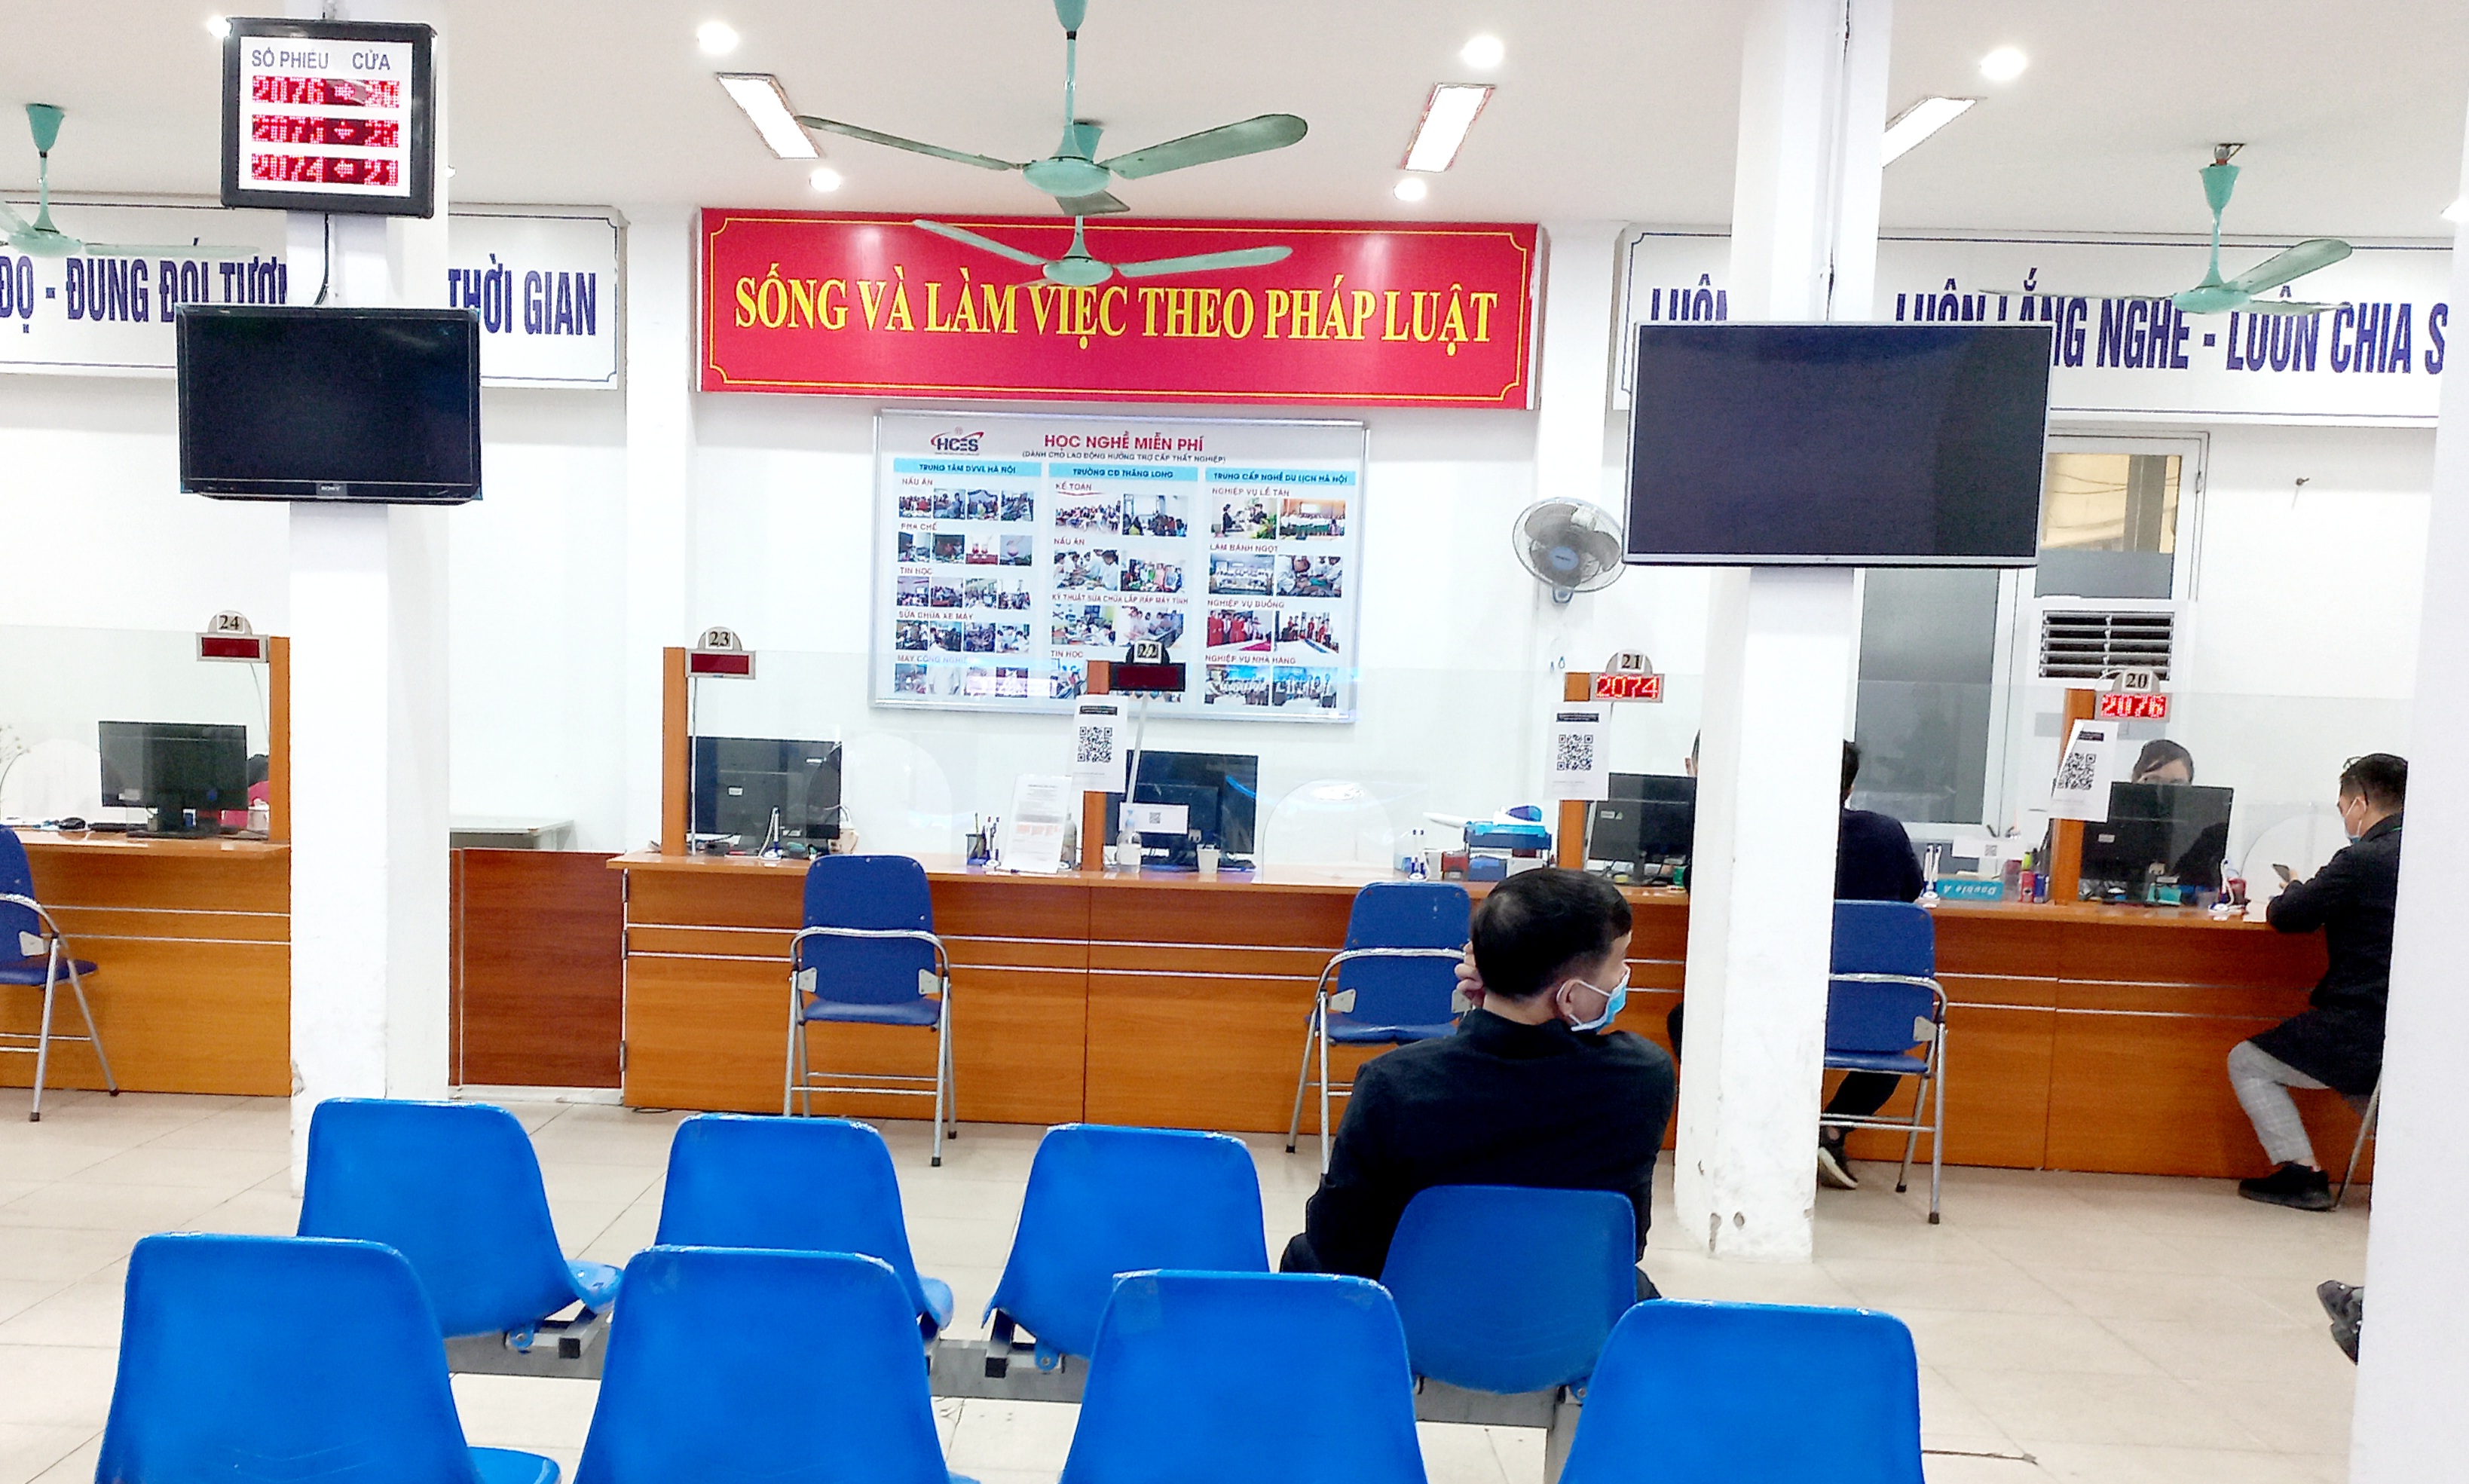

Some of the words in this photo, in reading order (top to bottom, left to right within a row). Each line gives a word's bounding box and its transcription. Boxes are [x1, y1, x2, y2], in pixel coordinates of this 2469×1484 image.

[252, 47, 275, 67] SỐ
[352, 49, 390, 70] CỬA
[252, 154, 324, 182] 2074
[365, 158, 398, 186] 21
[524, 270, 596, 335] GIAN
[735, 262, 849, 330] SỐNG
[856, 265, 914, 332] VÀ
[924, 267, 1019, 334] LÀM
[1137, 287, 1256, 339] THEO
[1263, 274, 1377, 341] PHÁP
[1381, 282, 1498, 356] LUẬT
[2096, 297, 2190, 369] NGHE
[2331, 301, 2412, 373] CHIA
[2425, 303, 2449, 375] S
[937, 438, 979, 451] HCES
[1045, 435, 1081, 451] HỌC
[1086, 430, 1129, 448] NGHỀ
[1134, 432, 1172, 450] MIỄN
[1177, 436, 1204, 451] PHÍ
[219, 615, 240, 630] 24
[709, 631, 730, 647] 23
[1137, 644, 1159, 658] 22
[1621, 654, 1641, 669] 21
[1596, 675, 1659, 699] 2074
[2126, 673, 2148, 689] 20
[2100, 693, 2166, 718] 2076
